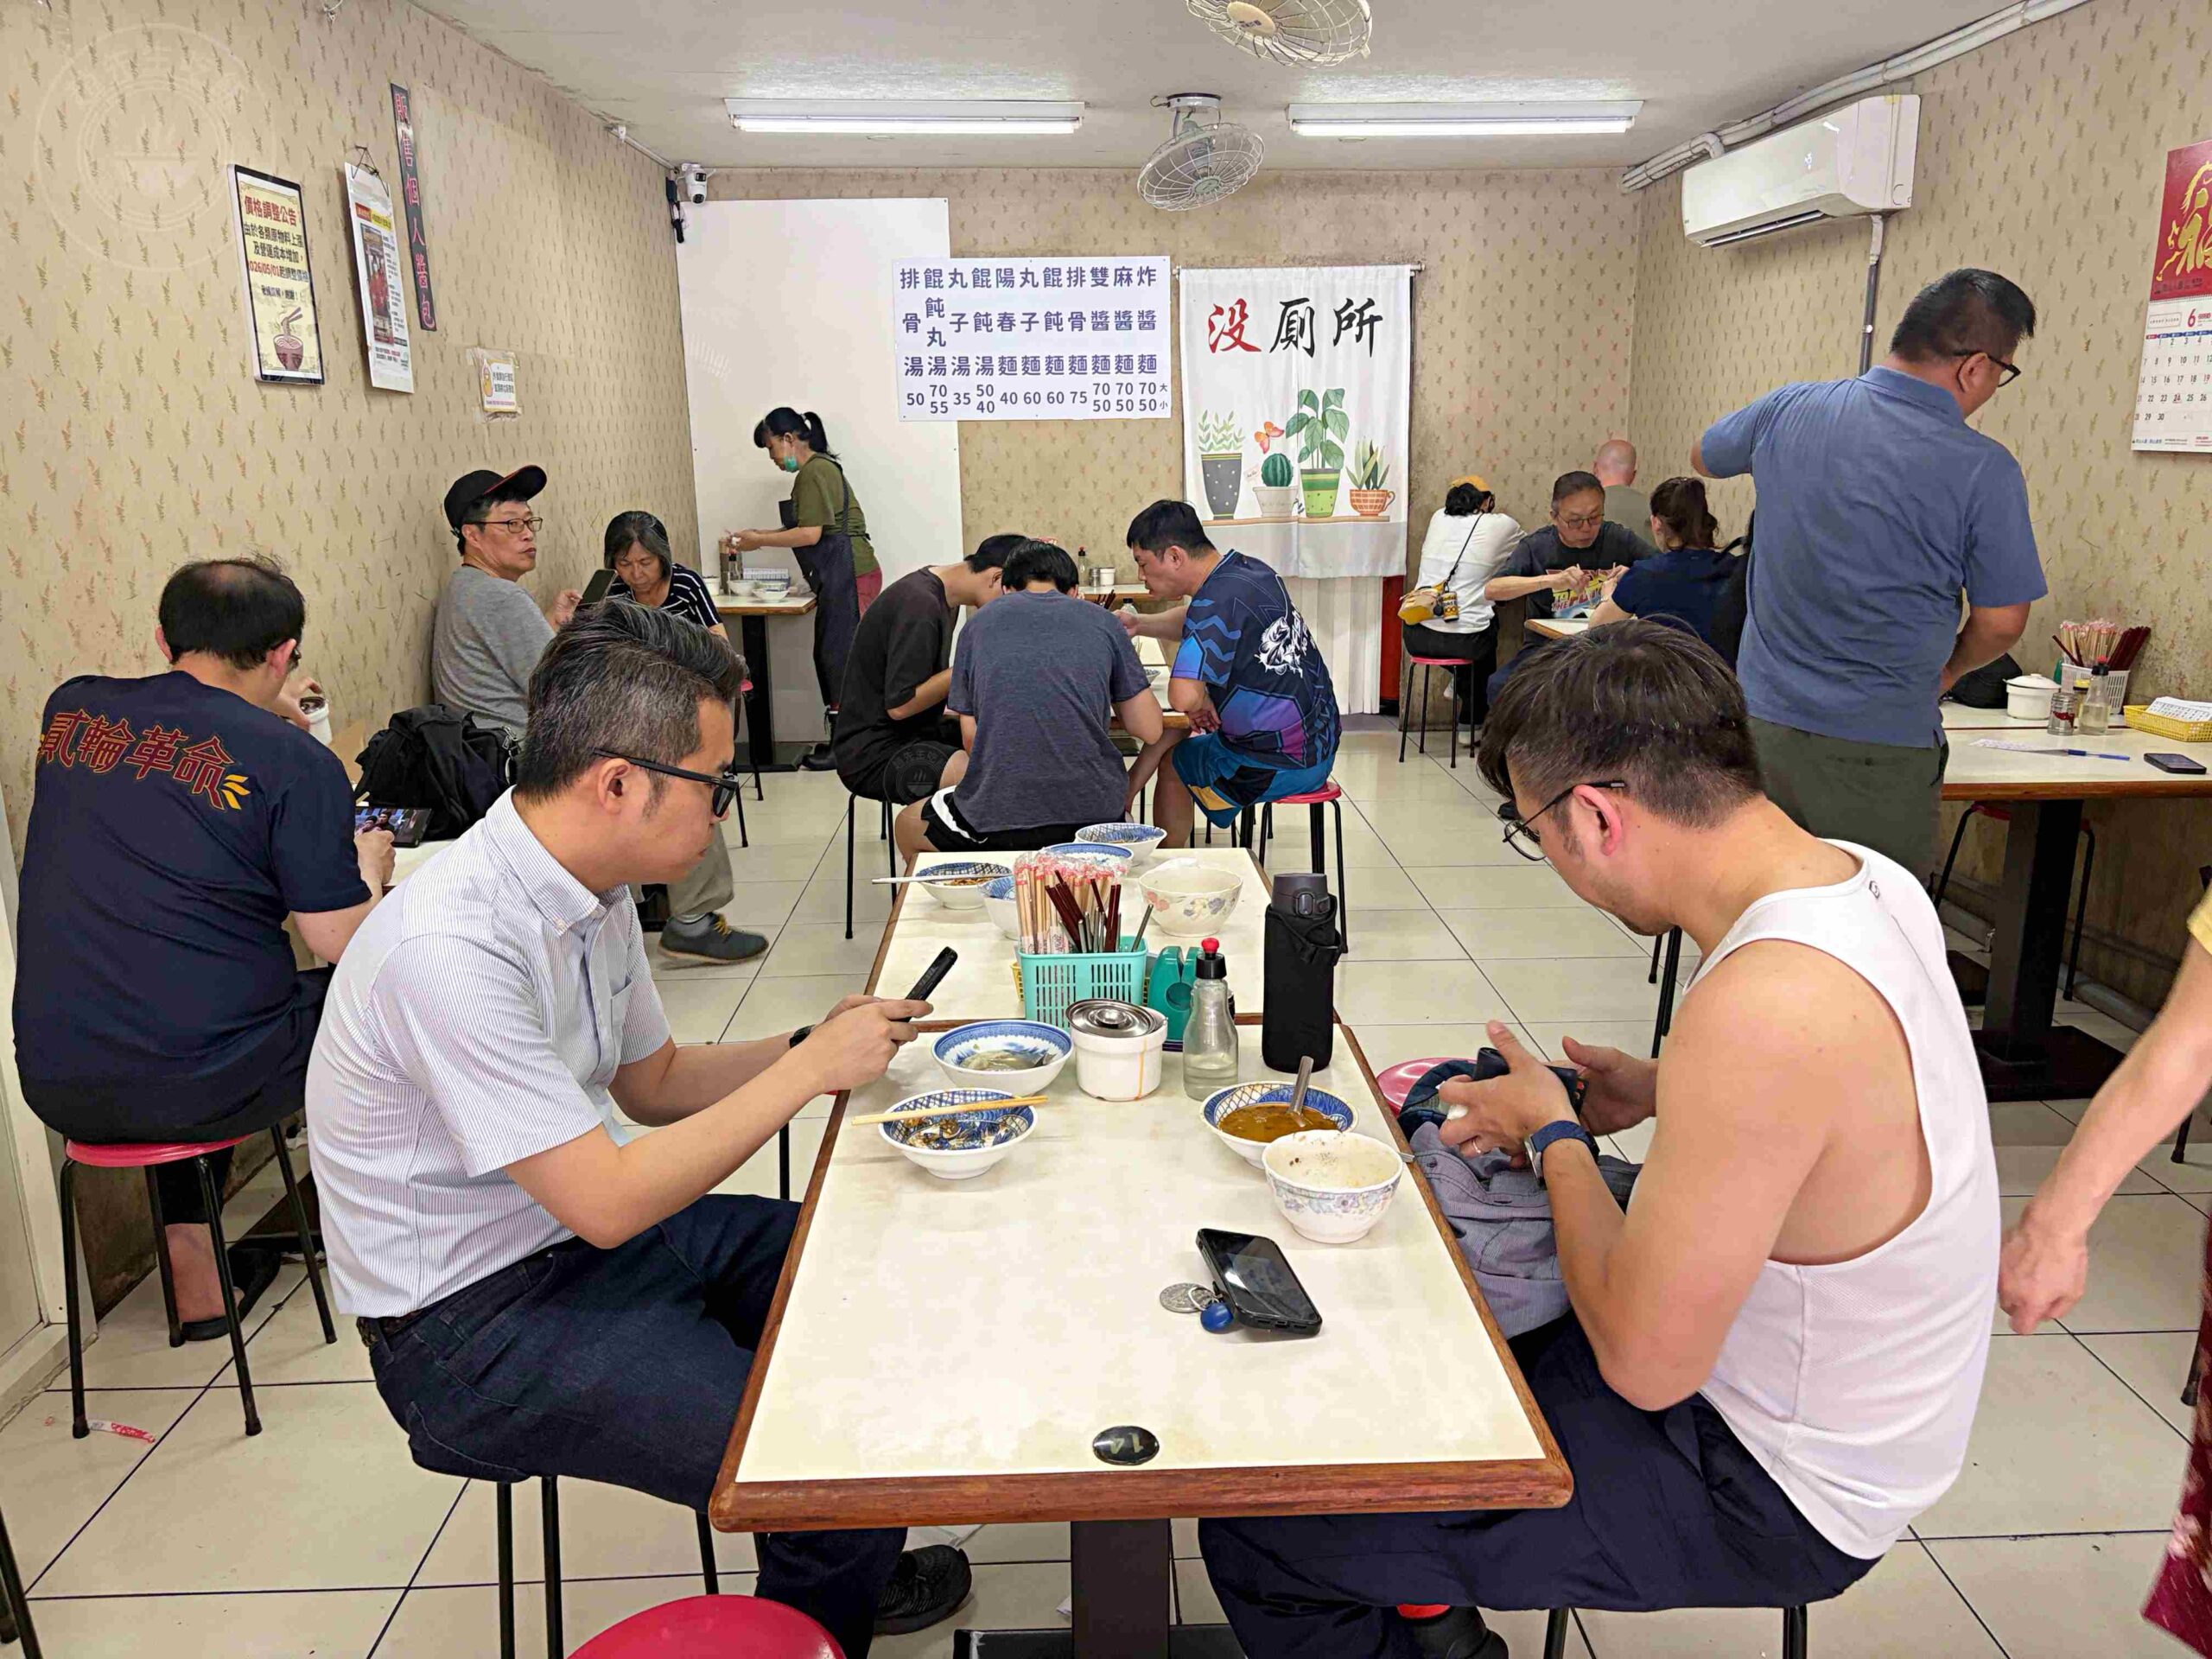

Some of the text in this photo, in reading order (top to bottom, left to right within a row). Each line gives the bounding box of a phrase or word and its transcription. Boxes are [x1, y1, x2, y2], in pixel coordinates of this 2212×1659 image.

[245, 195, 297, 227] 價格調整公告
[2187, 308, 2196, 327] 6
[929, 385, 947, 397] 70
[976, 385, 994, 397] 50
[1092, 383, 1110, 395] 70
[1116, 383, 1134, 395] 70
[1139, 382, 1168, 395] 70 大
[906, 392, 925, 405] 50
[953, 392, 971, 405] 35
[1000, 392, 1018, 404] 40
[1023, 392, 1041, 404] 60
[1046, 391, 1065, 404] 60
[1070, 391, 1088, 404] 75
[930, 401, 948, 414] 55
[976, 401, 995, 413] 40
[1092, 399, 1111, 412] 50
[1116, 399, 1134, 411] 50
[1139, 398, 1168, 411] 50 小
[41, 709, 234, 810] 貳輪革命
